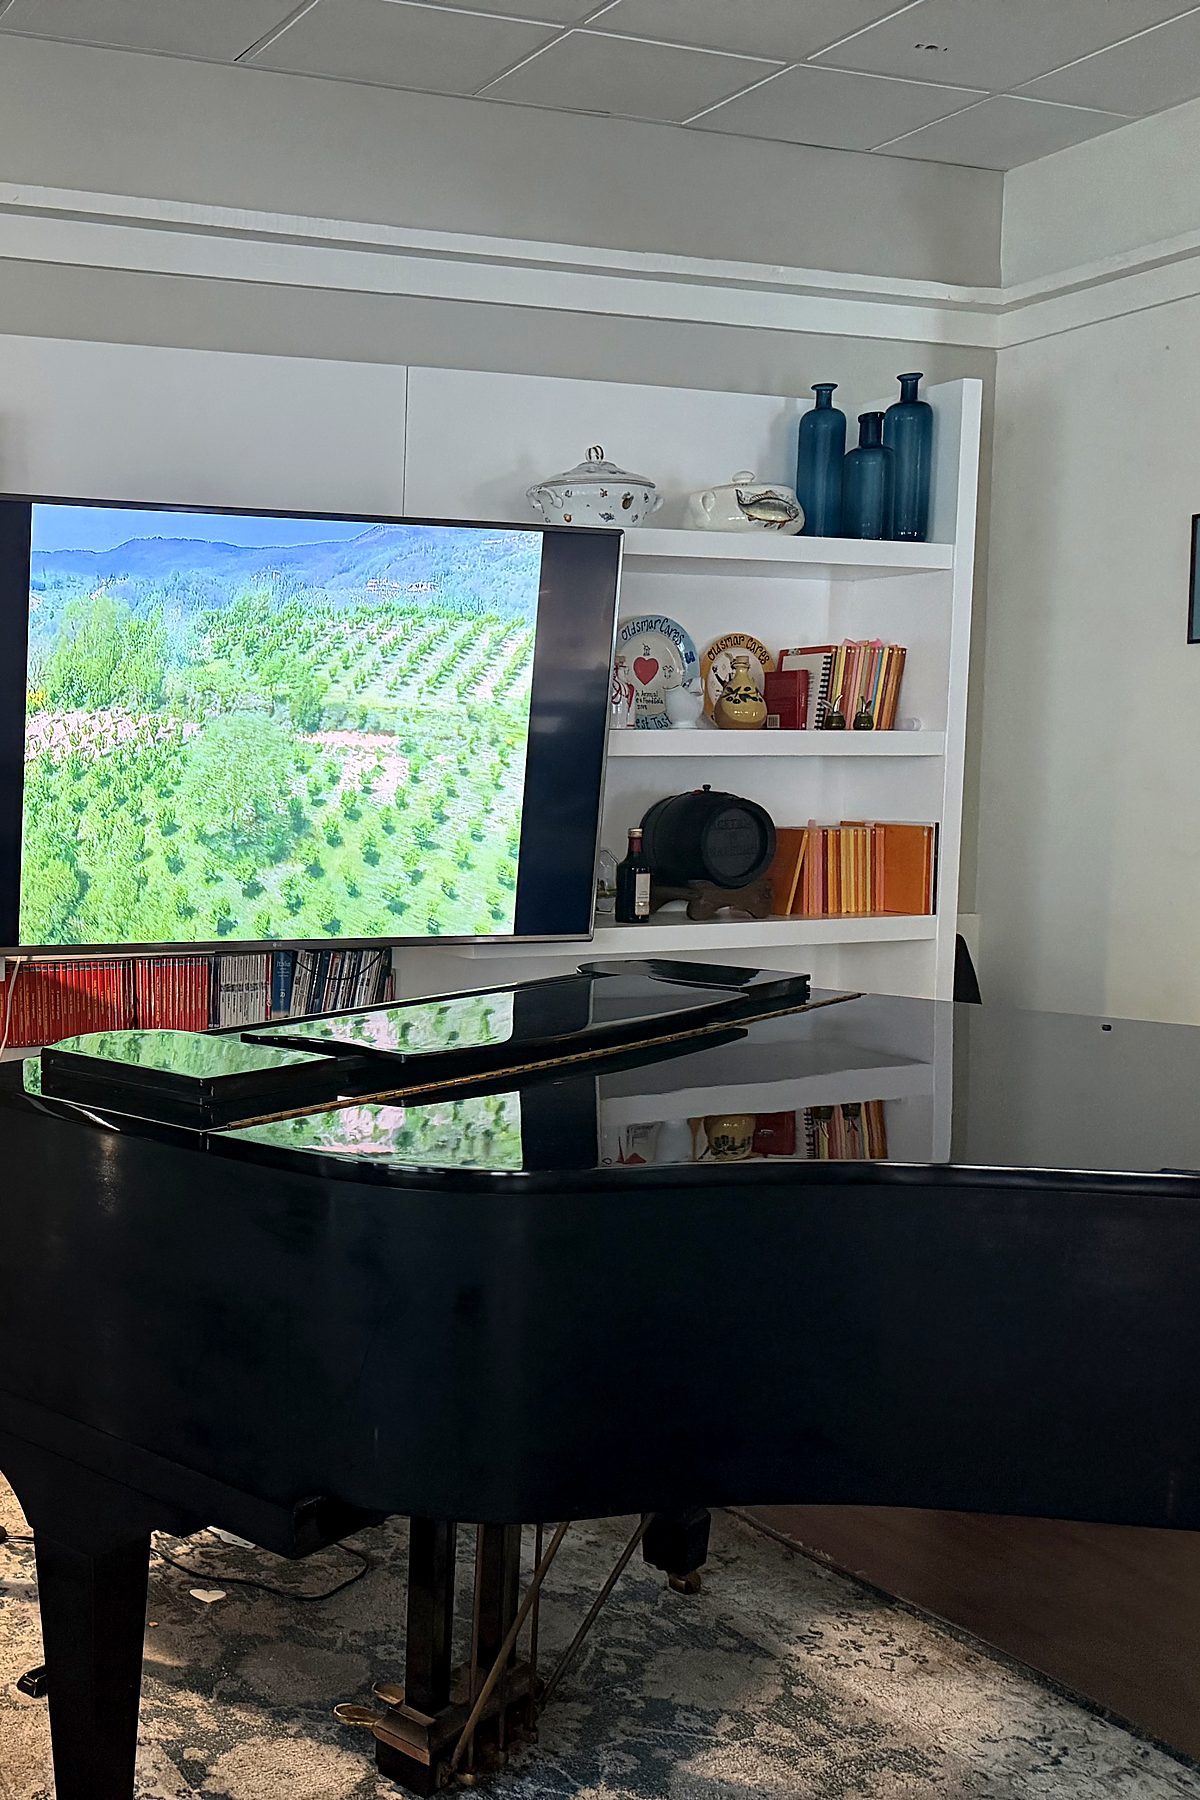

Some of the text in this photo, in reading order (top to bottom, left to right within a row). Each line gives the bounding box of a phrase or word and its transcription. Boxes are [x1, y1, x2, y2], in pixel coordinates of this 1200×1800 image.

[621, 617, 685, 646] Oldsmar Cares
[707, 635, 770, 665] Oldsmar Cares
